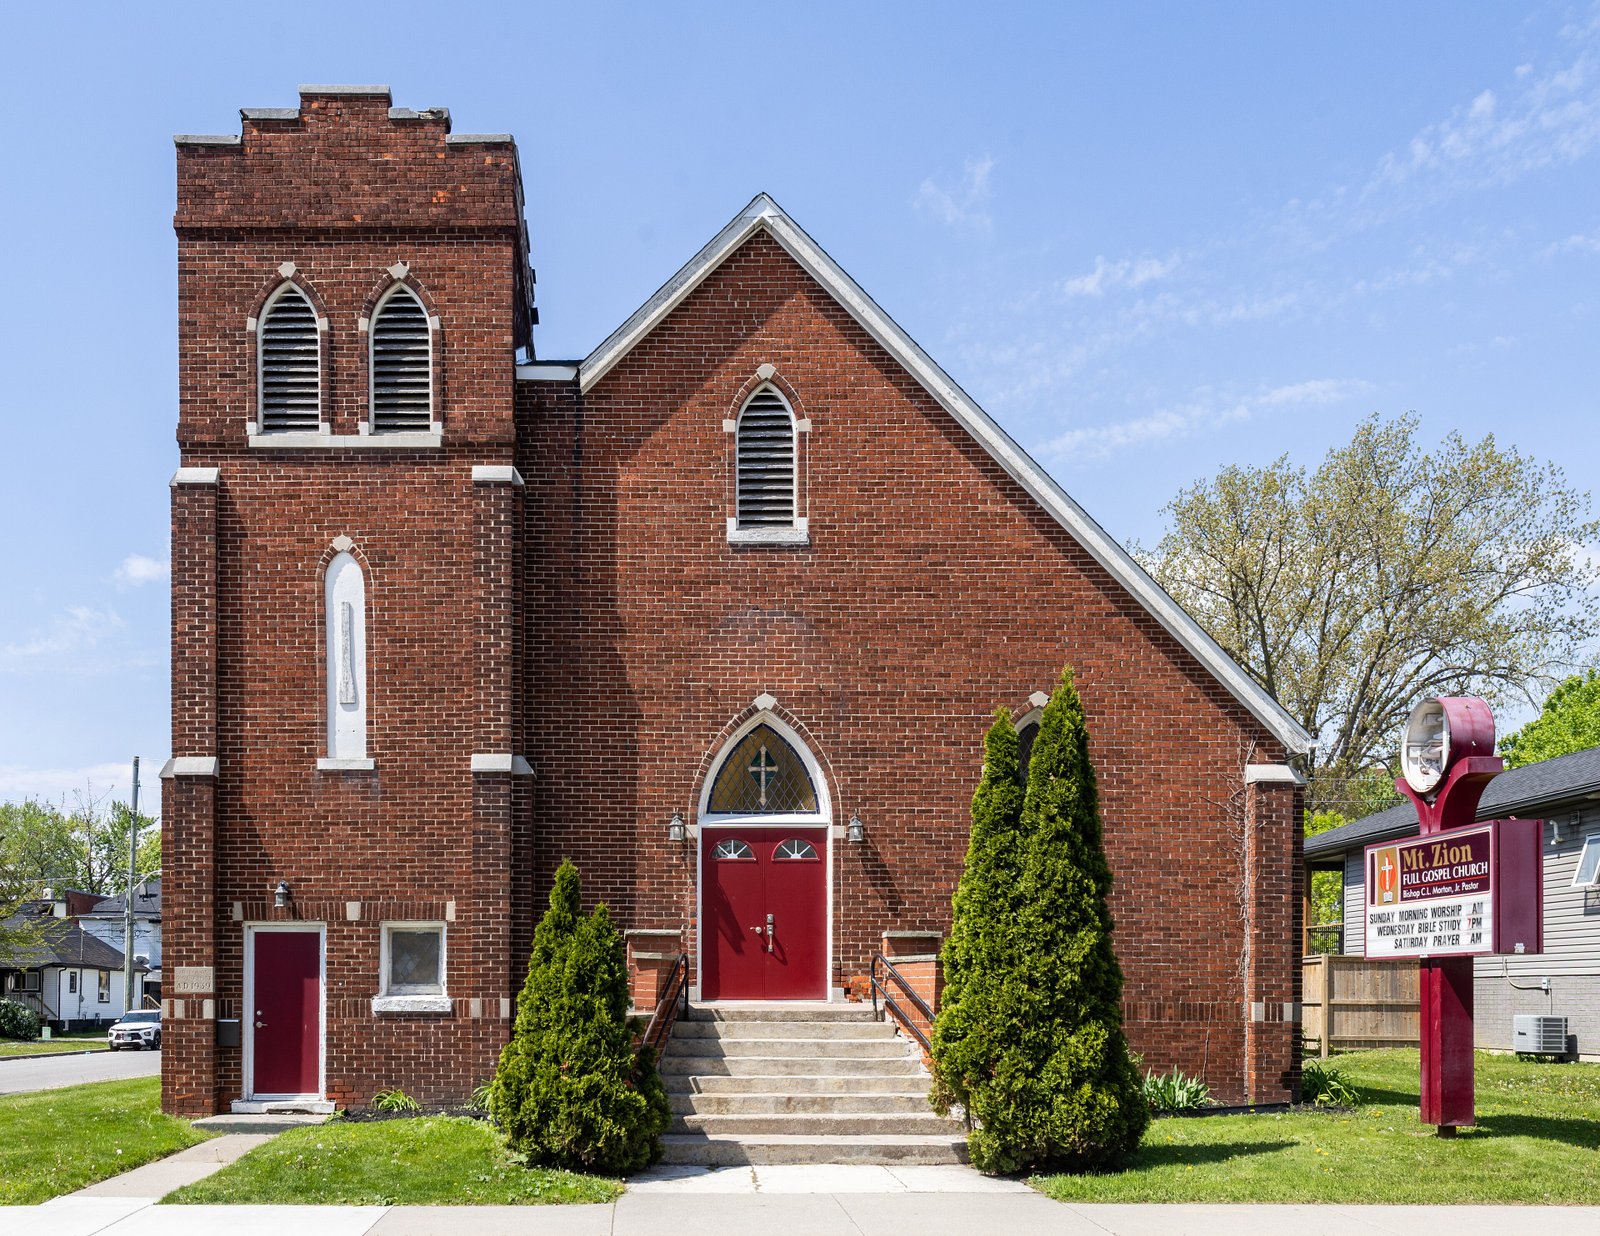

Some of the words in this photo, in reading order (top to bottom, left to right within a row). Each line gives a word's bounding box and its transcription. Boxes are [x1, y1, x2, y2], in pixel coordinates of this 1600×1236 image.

[1402, 848, 1429, 872] Mt.
[1431, 842, 1473, 867] Zion
[1403, 872, 1421, 885] FULL
[1421, 867, 1451, 883] GOSPEL
[1453, 861, 1488, 877] CHURCH
[1403, 888, 1420, 898] Bishop
[1420, 887, 1432, 896] C.L.
[1432, 884, 1453, 895] Morton,
[1461, 881, 1479, 891] Pastor
[1369, 912, 1395, 924] SUNDAY
[1399, 908, 1428, 921] MORNING
[1431, 904, 1462, 918] WORSHIP
[1377, 924, 1415, 937] WEDNESDAY
[1418, 921, 1437, 933] BIBLE
[1438, 919, 1461, 932] STUDY
[1394, 936, 1428, 949] SATURDAY
[1433, 933, 1460, 946] PRAYER
[1470, 932, 1482, 944] AM
